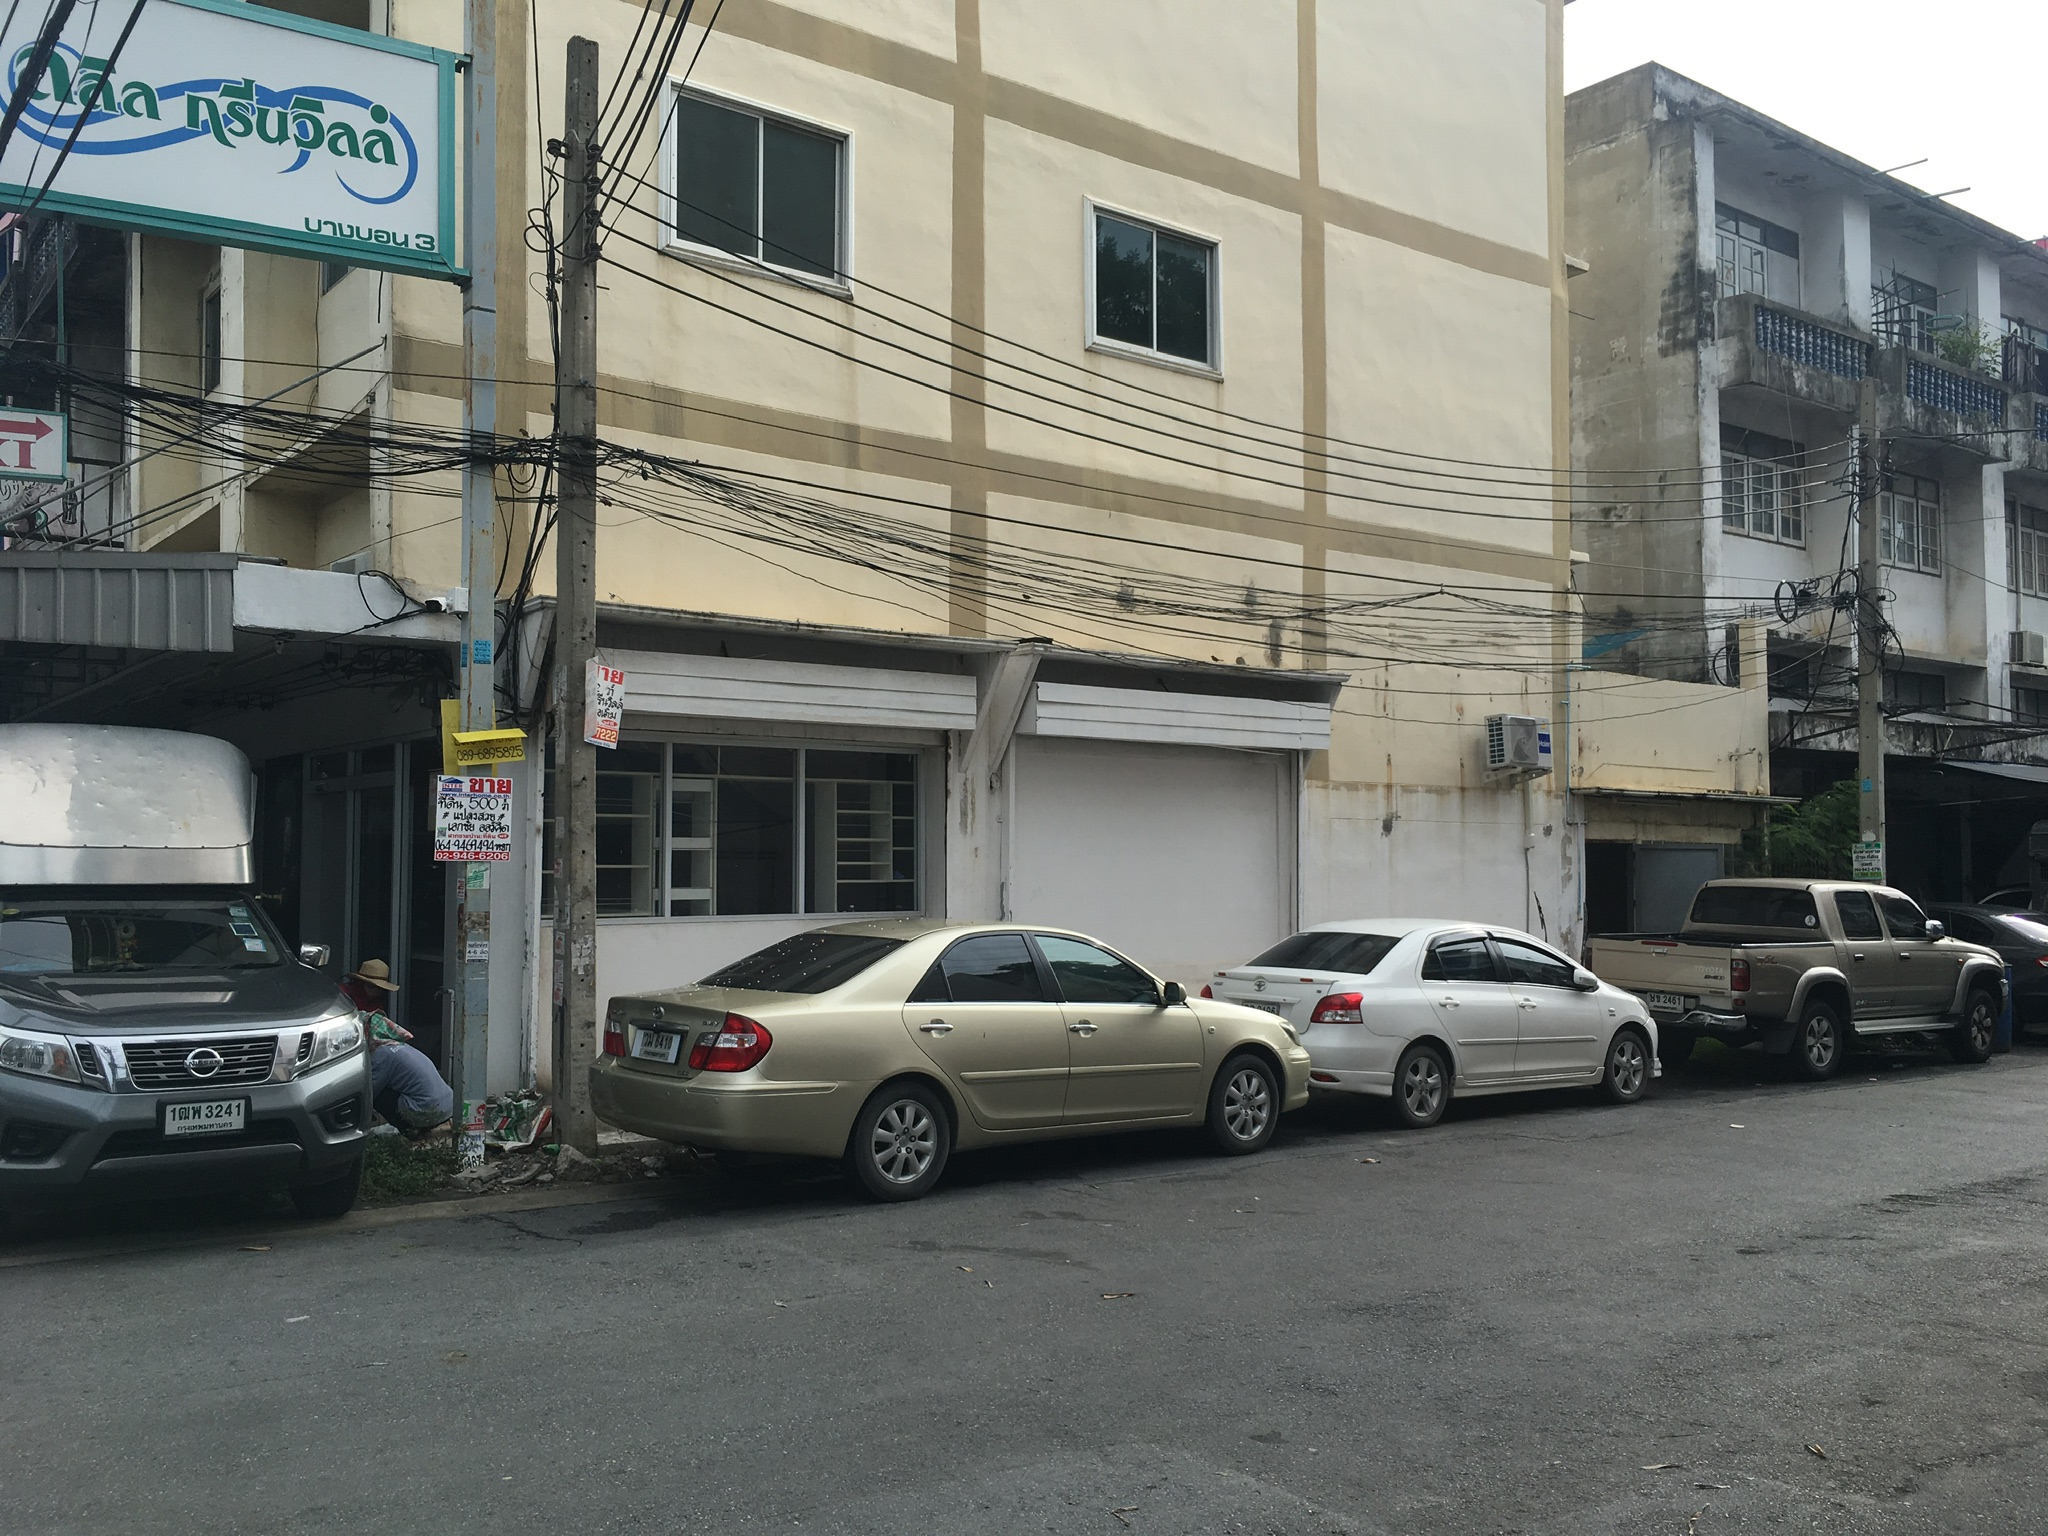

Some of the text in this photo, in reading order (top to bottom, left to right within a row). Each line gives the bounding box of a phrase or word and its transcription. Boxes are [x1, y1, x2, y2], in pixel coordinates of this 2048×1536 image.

[186, 77, 399, 167] กรีนวิลล์
[304, 217, 436, 252] บางบอน 3
[597, 665, 625, 685] าย
[457, 745, 523, 761] 089-6895825
[469, 778, 512, 794] ขาย
[469, 796, 499, 810] 500
[436, 852, 509, 860] 02-946-6206
[1694, 965, 1724, 974] TOYOTA
[1663, 995, 1681, 1006] 2461
[205, 1102, 241, 1119] 3241
[177, 1121, 233, 1133] กรุงเทพมหานคร
